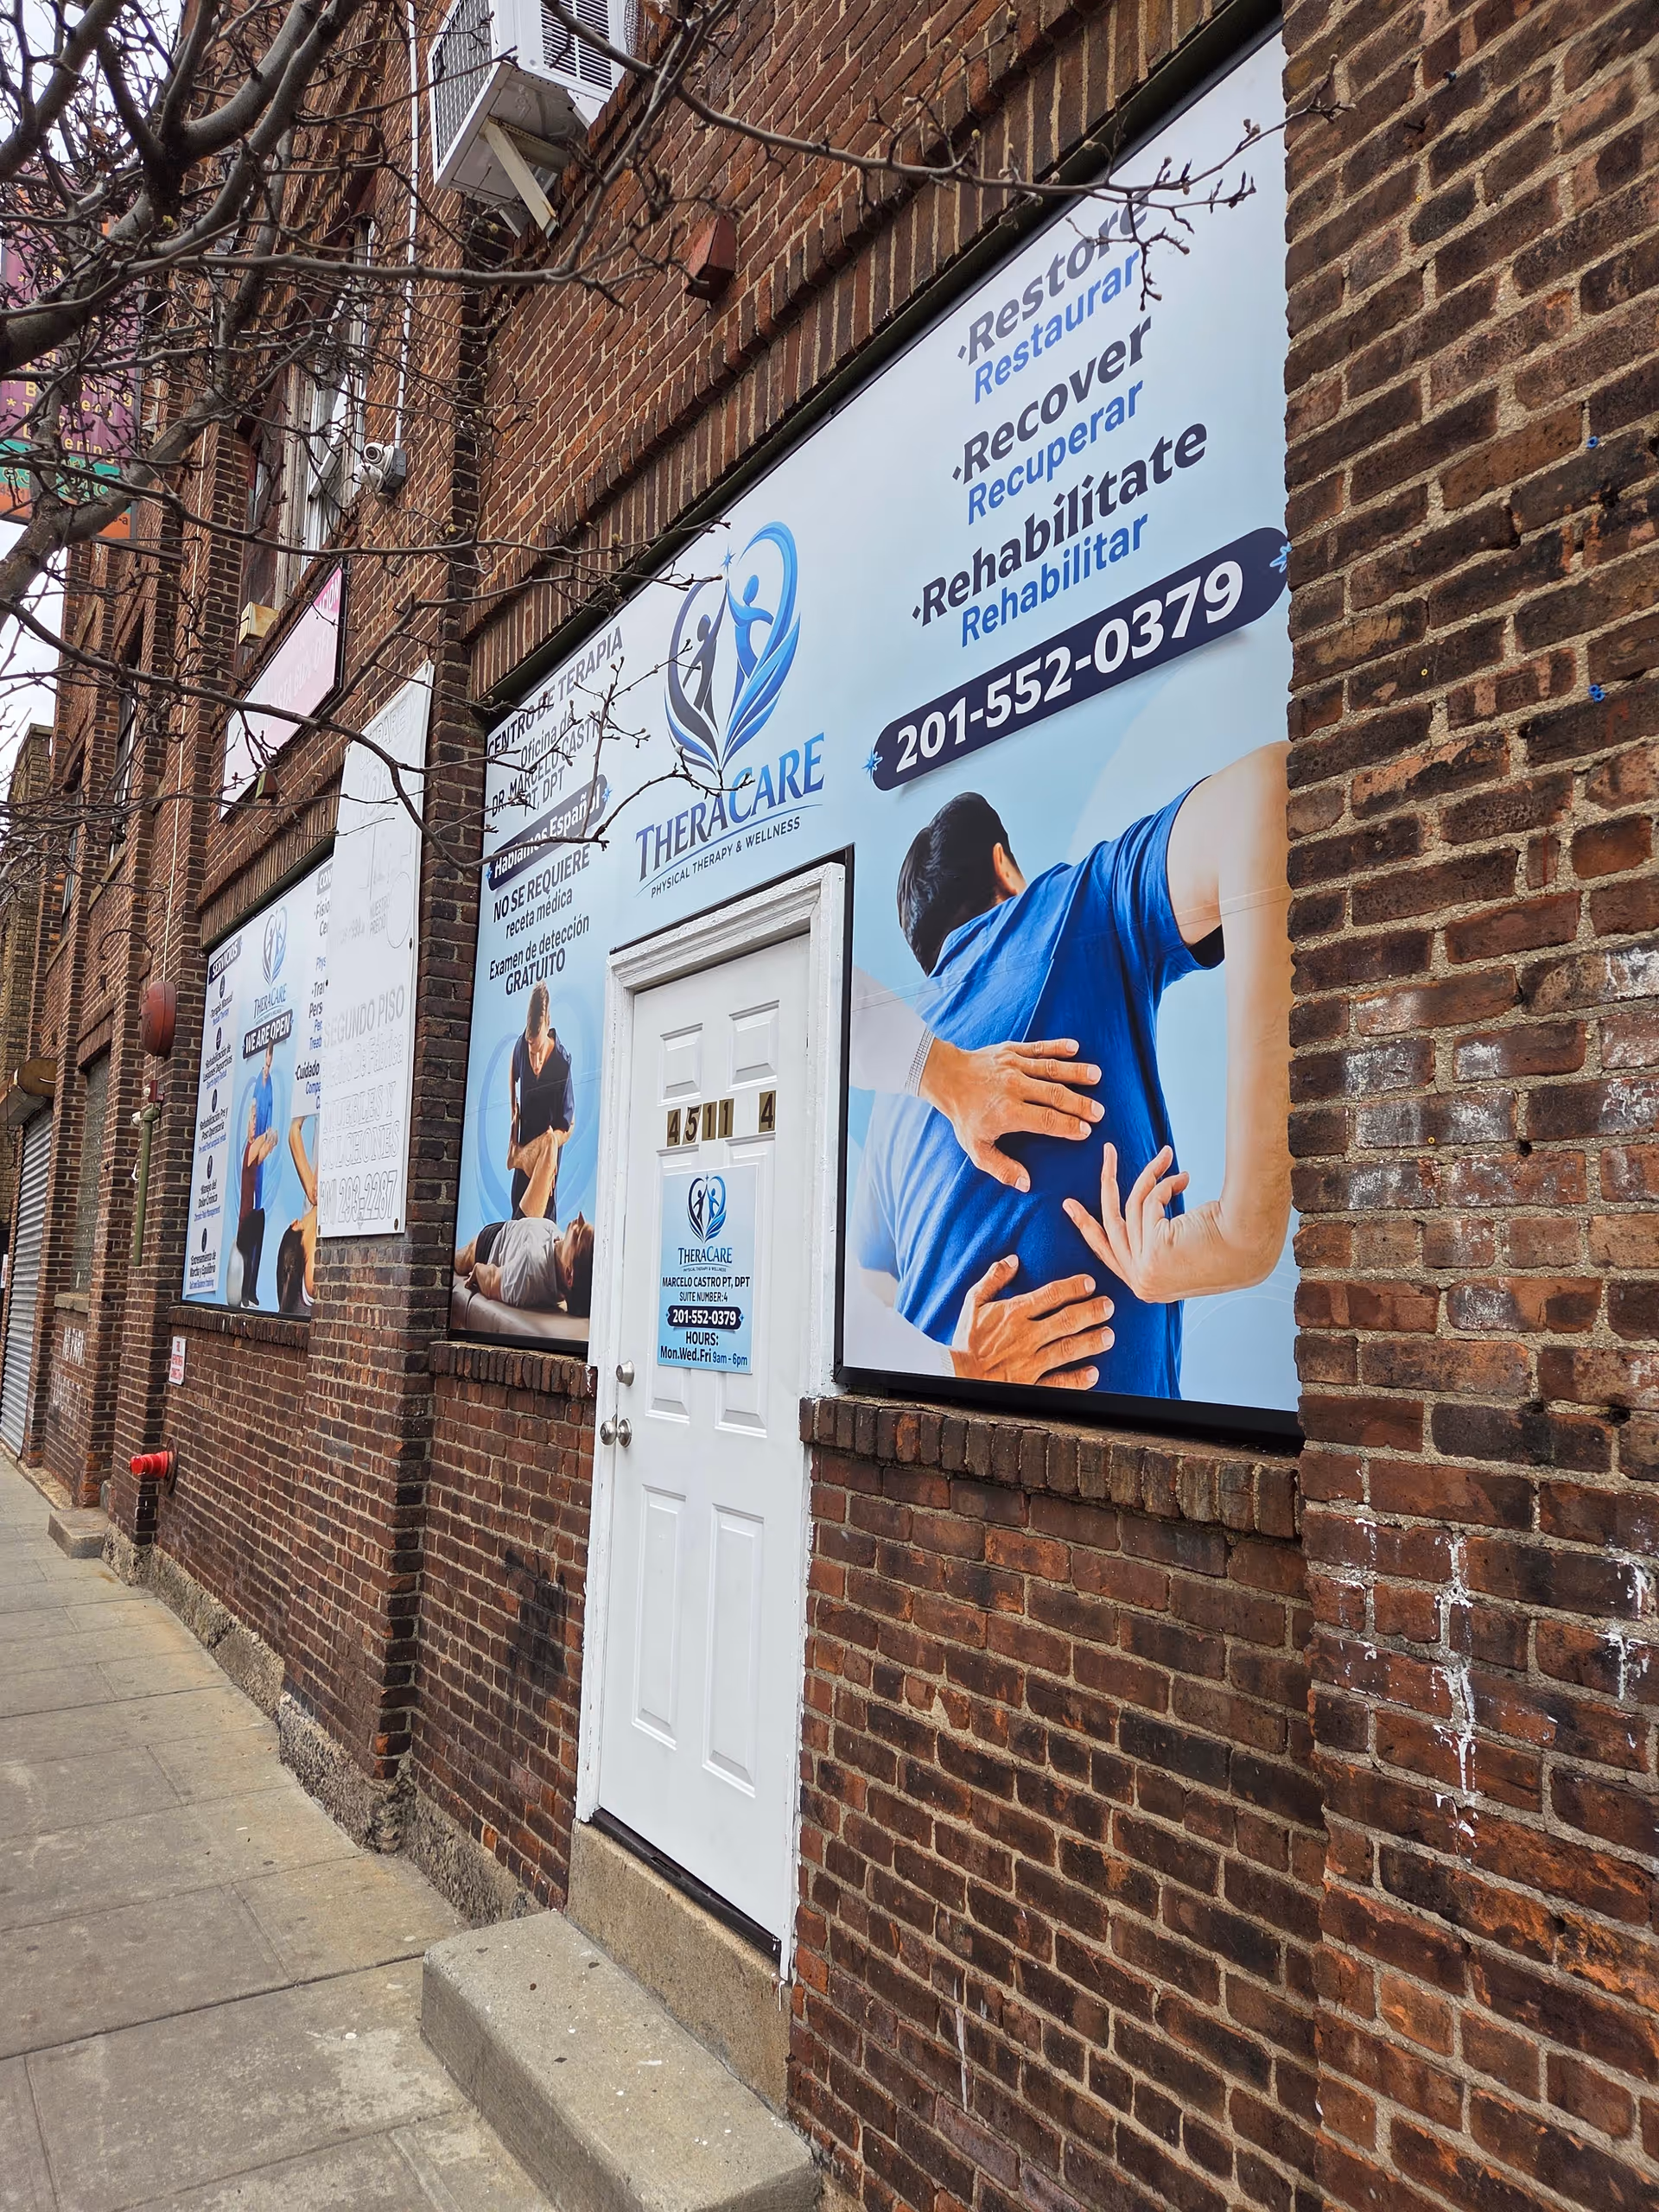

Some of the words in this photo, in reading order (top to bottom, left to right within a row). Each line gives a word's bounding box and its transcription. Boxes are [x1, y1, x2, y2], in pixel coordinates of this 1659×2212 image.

[966, 191, 1149, 367] Restore
[975, 250, 1140, 404] Restaurar
[963, 316, 1151, 485] Recover
[22, 422, 115, 465] Lering
[968, 381, 1143, 525] Recuperar
[921, 423, 1207, 626] Rehabilitate
[962, 514, 1147, 647] Rehabilitar
[487, 704, 535, 758] CENTRO
[537, 684, 554, 721] DE
[558, 626, 623, 702] TERAPIA
[896, 561, 1243, 772] 201-552-0379
[520, 726, 556, 768] Oficina
[560, 710, 573, 734] de
[562, 706, 608, 762] CASTR
[543, 765, 565, 803] DPT
[493, 896, 509, 923] NO
[512, 890, 525, 912] SE
[526, 844, 591, 903] REQUIERE
[651, 867, 690, 898] PHYSICAL
[692, 842, 733, 874] THERAPY
[735, 841, 742, 853] &
[745, 817, 800, 849] WELLNESS
[505, 910, 534, 939] receta
[537, 887, 573, 923] médica
[212, 940, 238, 978] SERVICIOS
[490, 949, 524, 981] Examen
[525, 940, 537, 963] de
[539, 913, 589, 956] detección
[505, 948, 566, 995] GRATUITO
[245, 1032, 257, 1054] WE
[257, 1024, 270, 1049] ARE
[270, 1014, 291, 1040] OPEN
[324, 999, 375, 1048] SEGUNDO
[378, 984, 404, 1027] PISO
[296, 1059, 320, 1081] Cuidado
[760, 1092, 774, 1130] 4
[321, 1120, 400, 1171] COLCHONES
[338, 1169, 397, 1224] 293-2287
[662, 1276, 693, 1287] MARCELO
[693, 1276, 721, 1287] CASTRO
[721, 1276, 734, 1289] PT,
[734, 1276, 750, 1287] DPT
[679, 1291, 696, 1301] SUITE
[672, 1309, 736, 1325] 201-552-0379
[685, 1331, 719, 1346] HOURS:
[660, 1345, 711, 1362] Mon.Wed.Fri
[712, 1351, 727, 1363] 9am
[733, 1353, 747, 1368] 6pm
